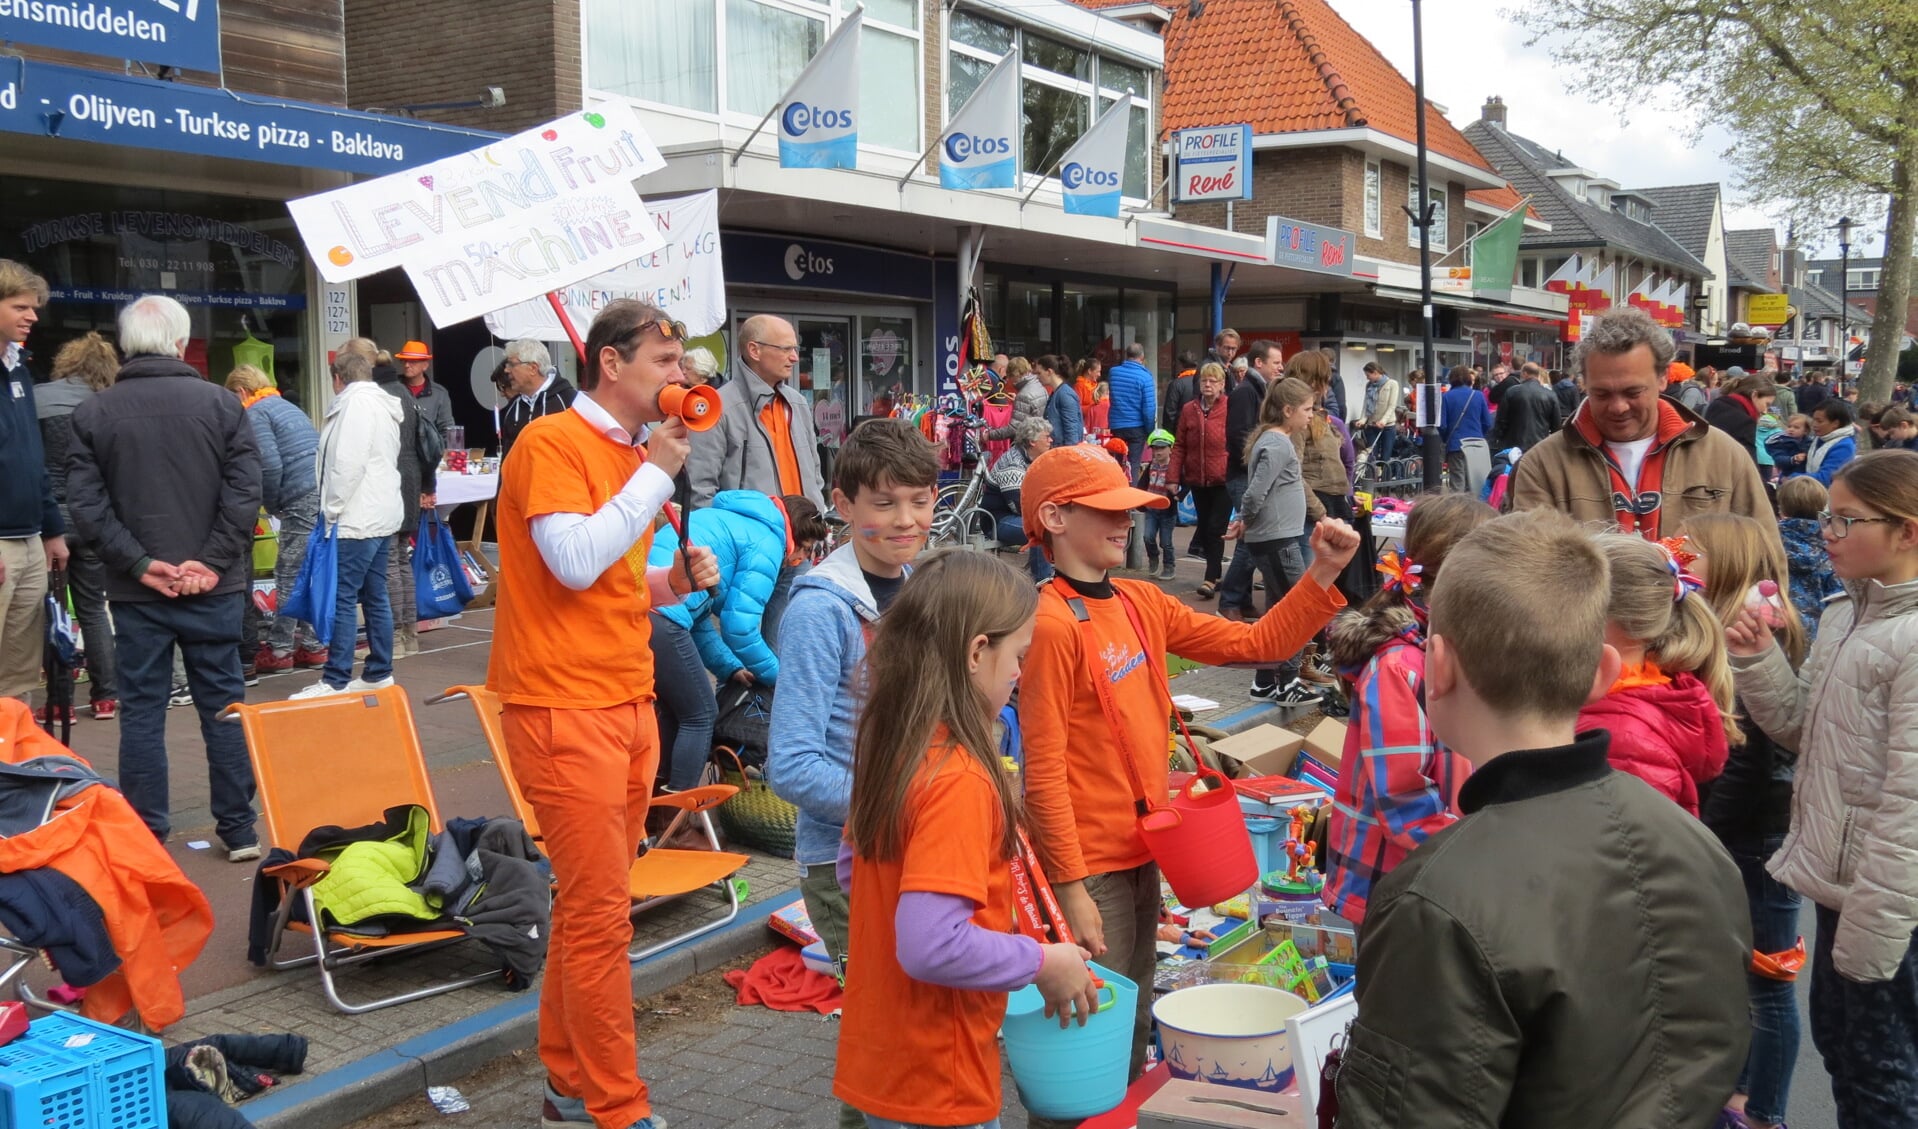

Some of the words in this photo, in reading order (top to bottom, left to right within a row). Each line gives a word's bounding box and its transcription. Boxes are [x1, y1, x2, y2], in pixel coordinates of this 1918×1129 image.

[69, 94, 156, 130] Olijven
[176, 108, 250, 141] Turkse
[258, 122, 310, 149] pizza
[331, 130, 404, 161] Baklava
[784, 104, 852, 133] etos
[947, 134, 1009, 160] etos
[1185, 132, 1238, 150] PROFILE
[1063, 164, 1118, 187] etos
[1189, 166, 1236, 196] René
[21, 213, 103, 253] TURKSE
[112, 211, 296, 270] LEVENSMIDDELEN
[1280, 224, 1316, 253] PROFILE
[1322, 235, 1347, 268] René
[139, 258, 158, 269] 030
[787, 247, 833, 277] etos
[73, 289, 94, 299] Fruit
[208, 295, 232, 304] Turkse
[329, 291, 345, 303] 127
